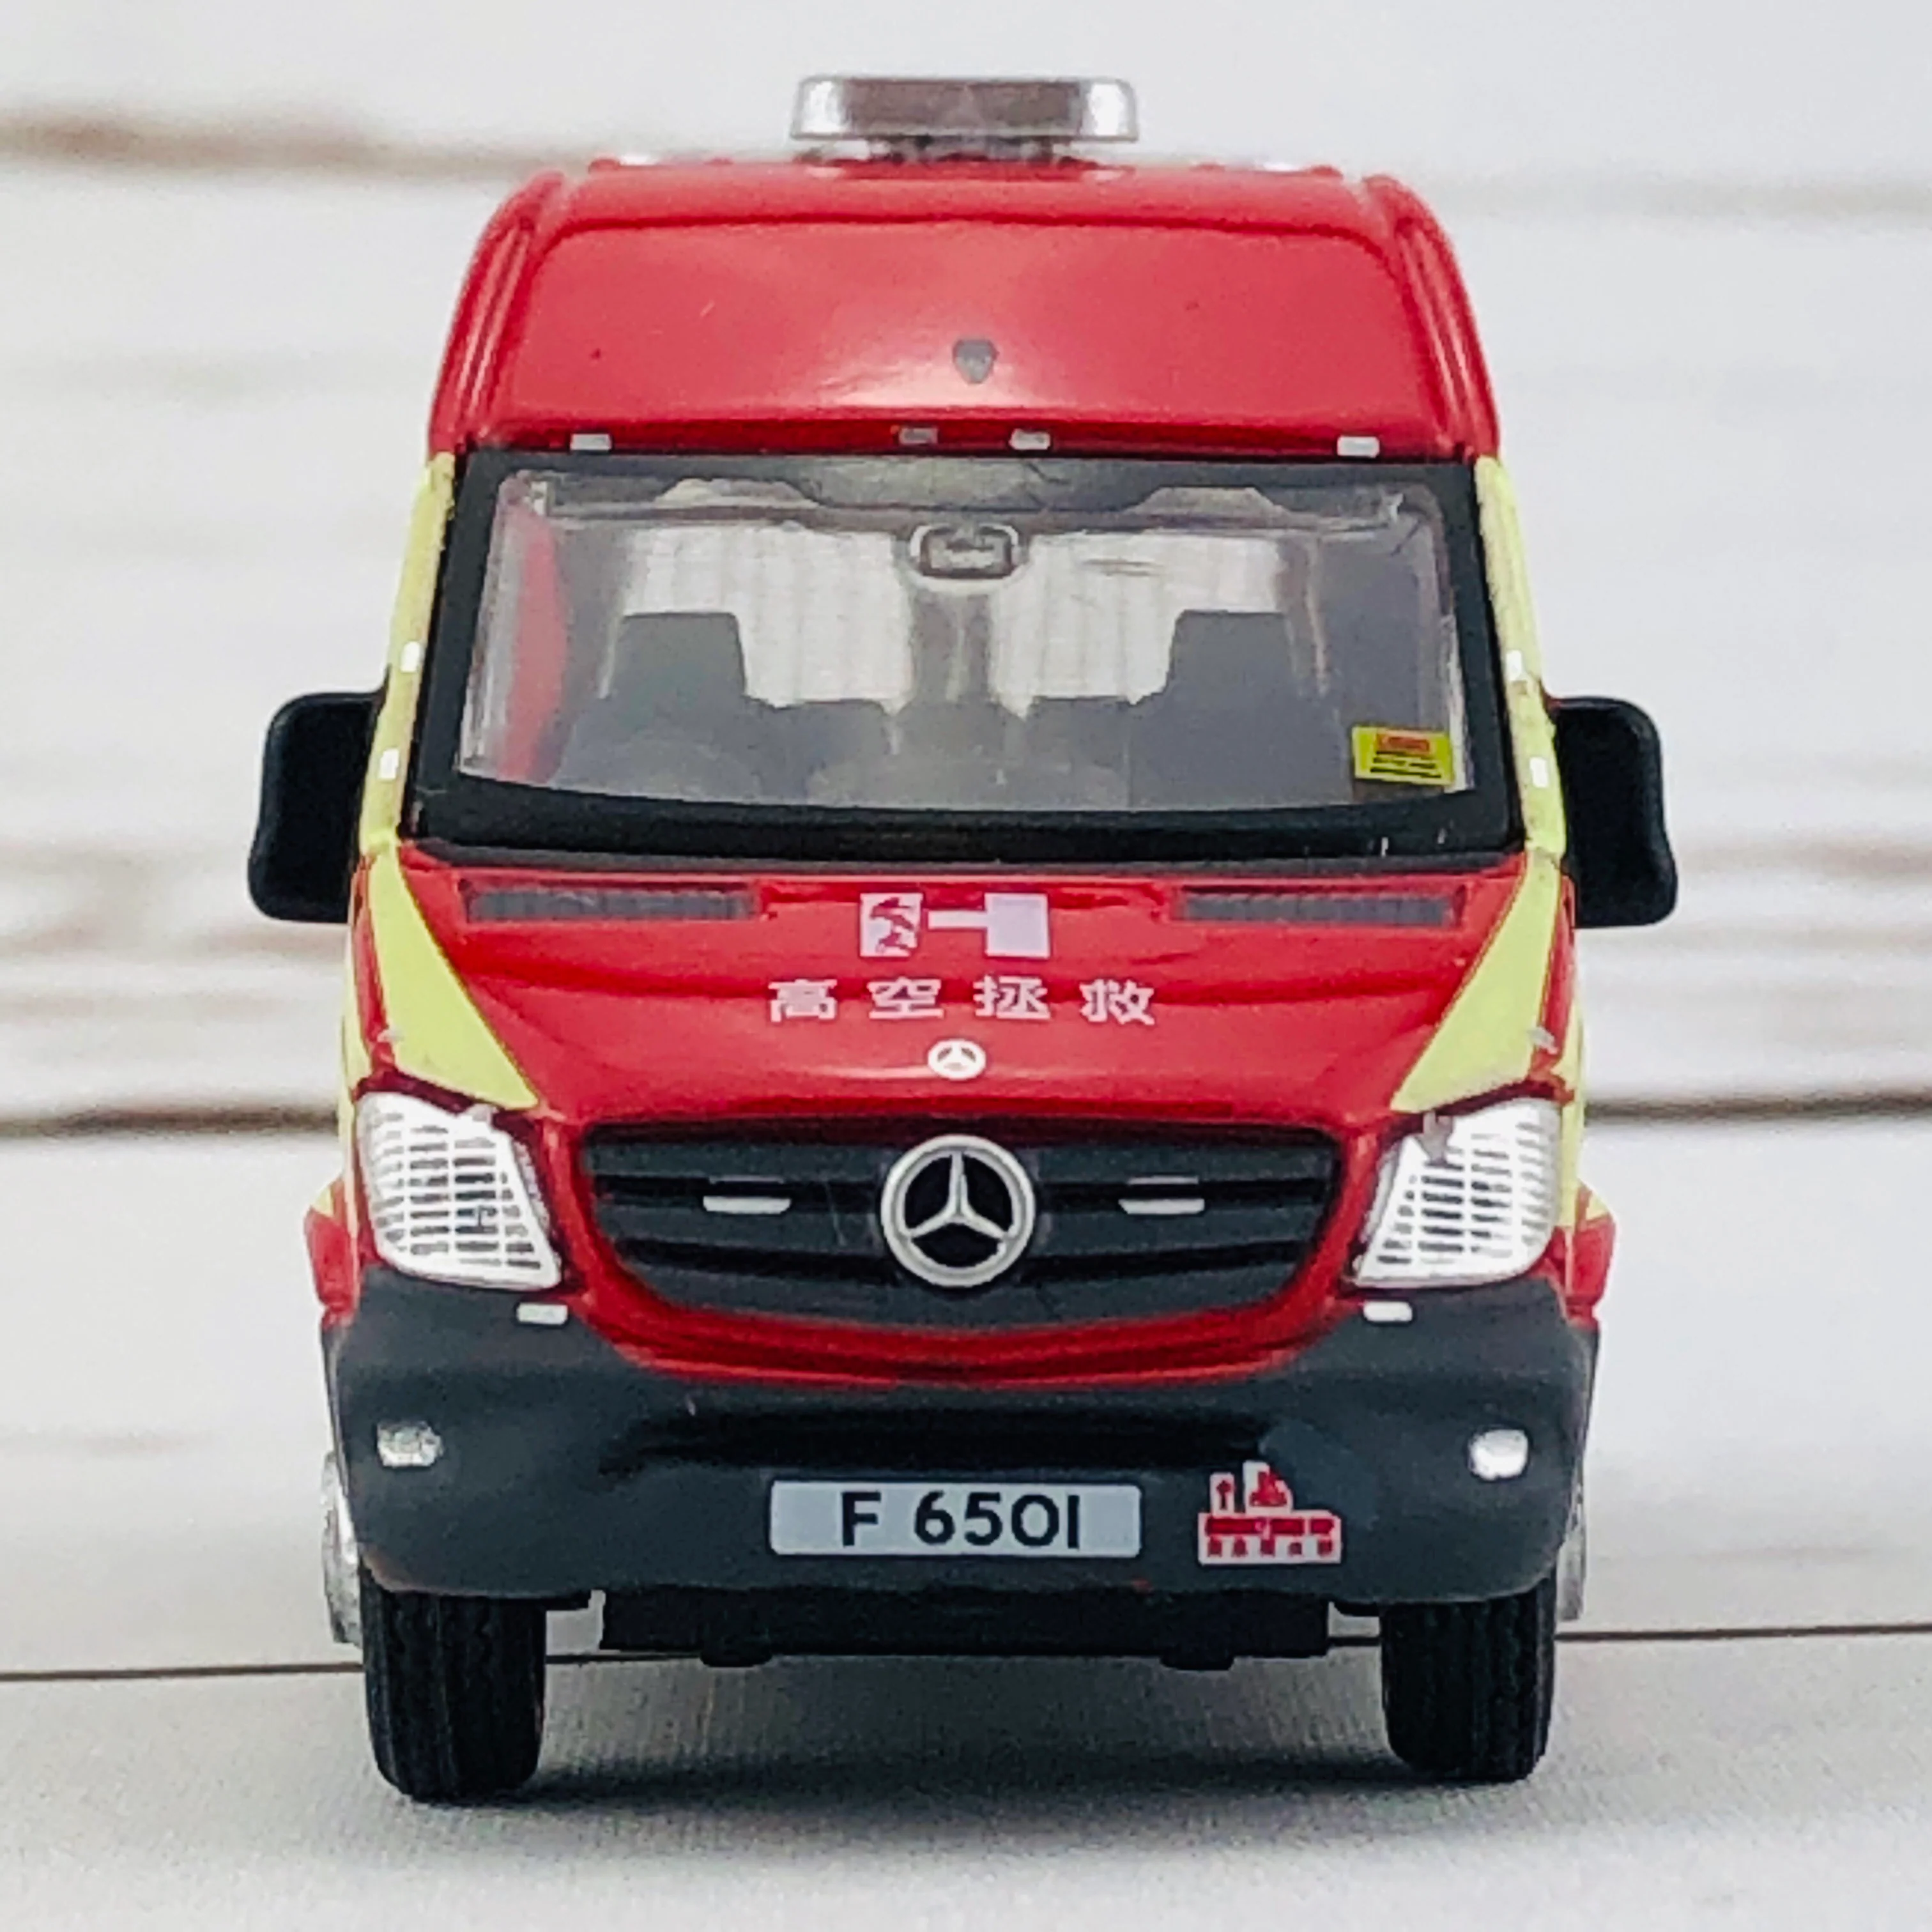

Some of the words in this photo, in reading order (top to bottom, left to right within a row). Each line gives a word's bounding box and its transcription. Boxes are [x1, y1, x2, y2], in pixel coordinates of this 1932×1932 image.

[768, 974, 1155, 1025] 高空拯救
[841, 1491, 882, 1547] F
[913, 1491, 1080, 1550] 6501
